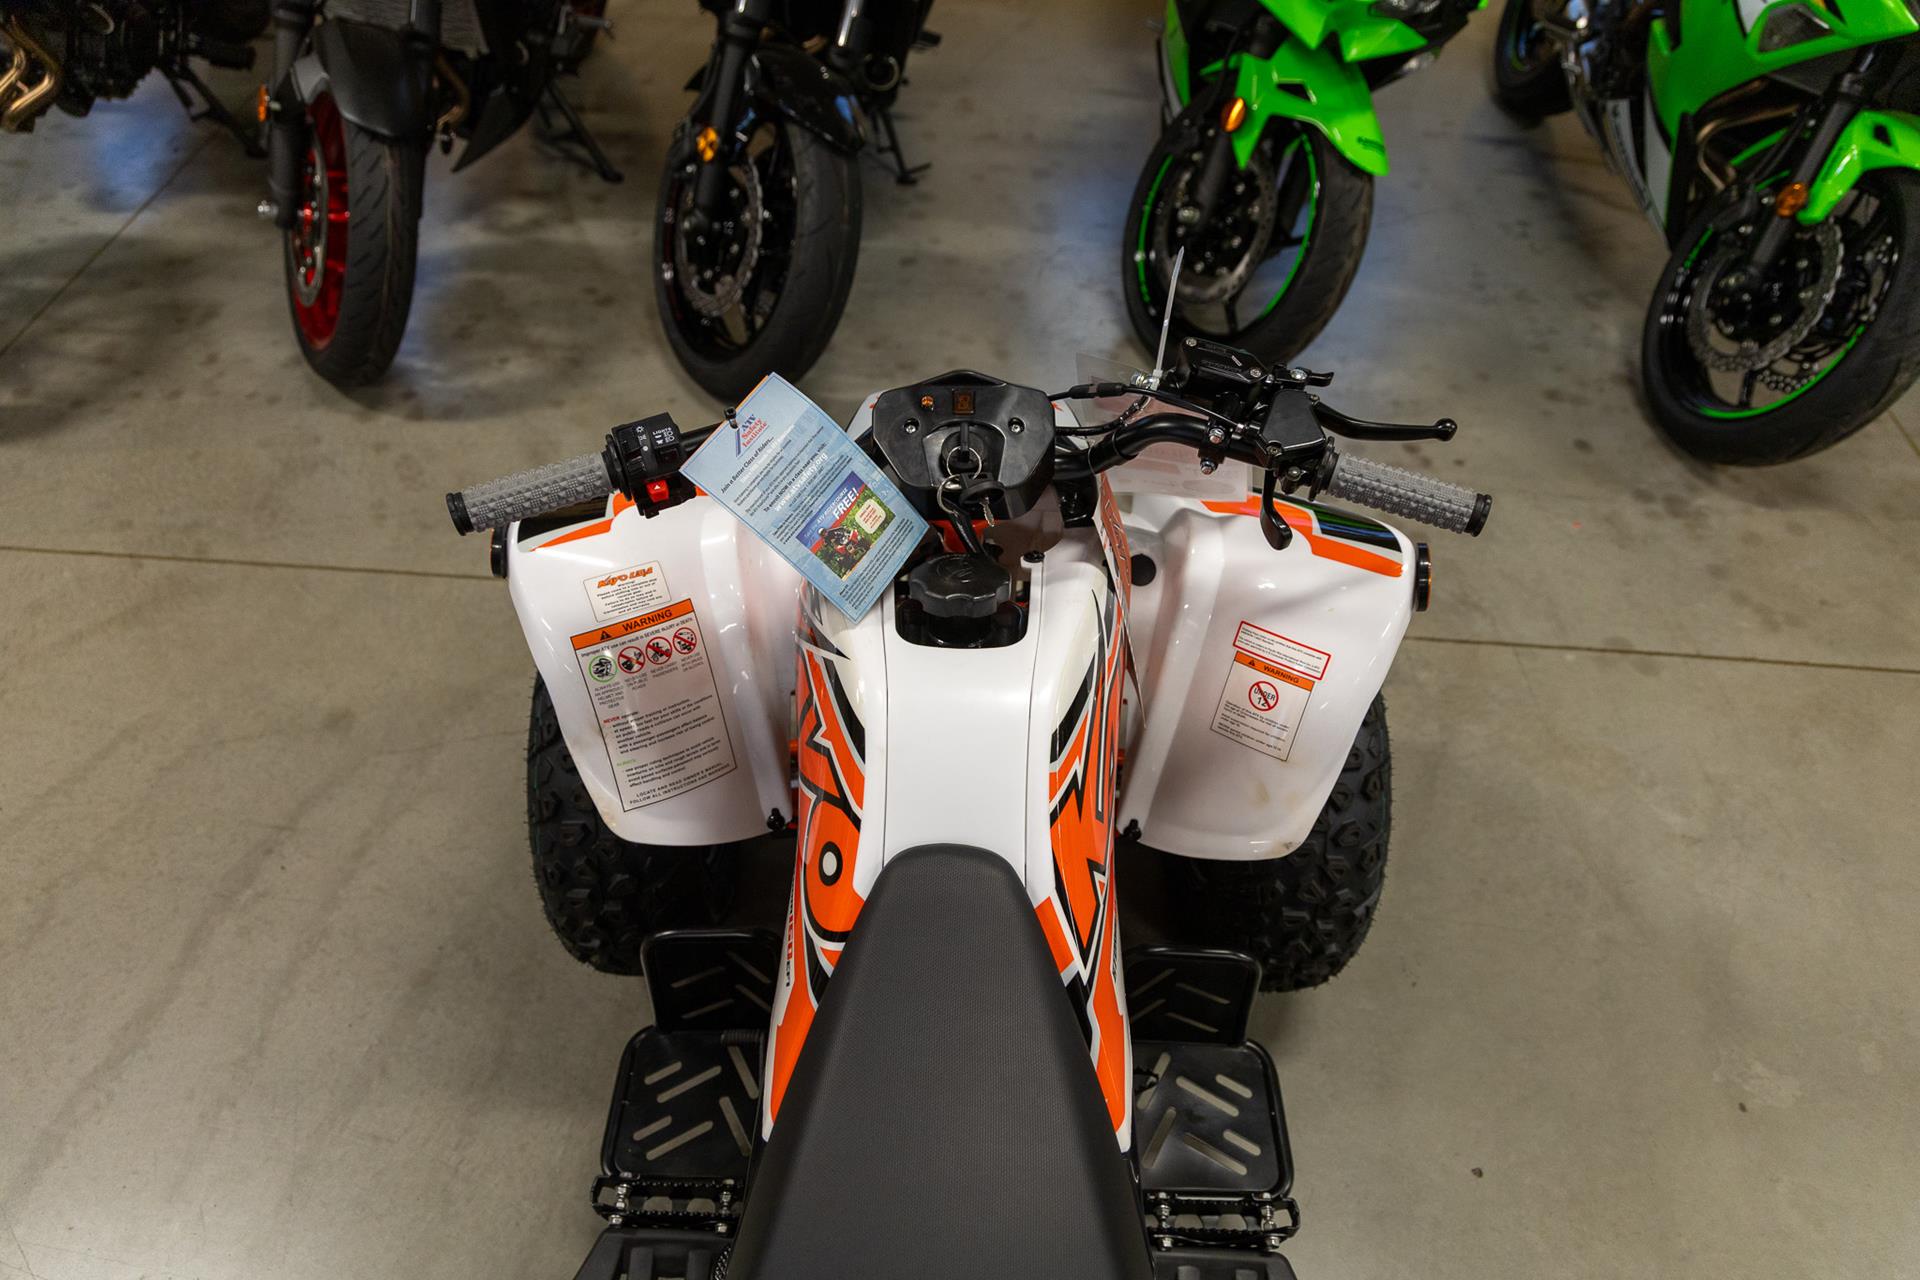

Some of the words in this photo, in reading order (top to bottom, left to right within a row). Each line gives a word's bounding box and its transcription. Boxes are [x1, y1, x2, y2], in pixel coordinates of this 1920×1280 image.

[741, 414, 756, 432] ATV
[741, 418, 762, 440] Safety
[742, 422, 767, 448] Institute
[720, 483, 731, 494] Join
[731, 466, 745, 481] Better
[743, 456, 756, 468] Class
[753, 450, 760, 458] of
[768, 494, 781, 508] enroll
[778, 484, 789, 496] NOW
[794, 468, 804, 479] class
[802, 459, 811, 470] near
[774, 453, 828, 512] www.atvsafety.org
[831, 487, 859, 519] FREE!
[622, 609, 672, 632] WARNING
[1263, 665, 1299, 683] WARNING
[1254, 687, 1276, 701] UNDER
[1257, 696, 1269, 708] 12
